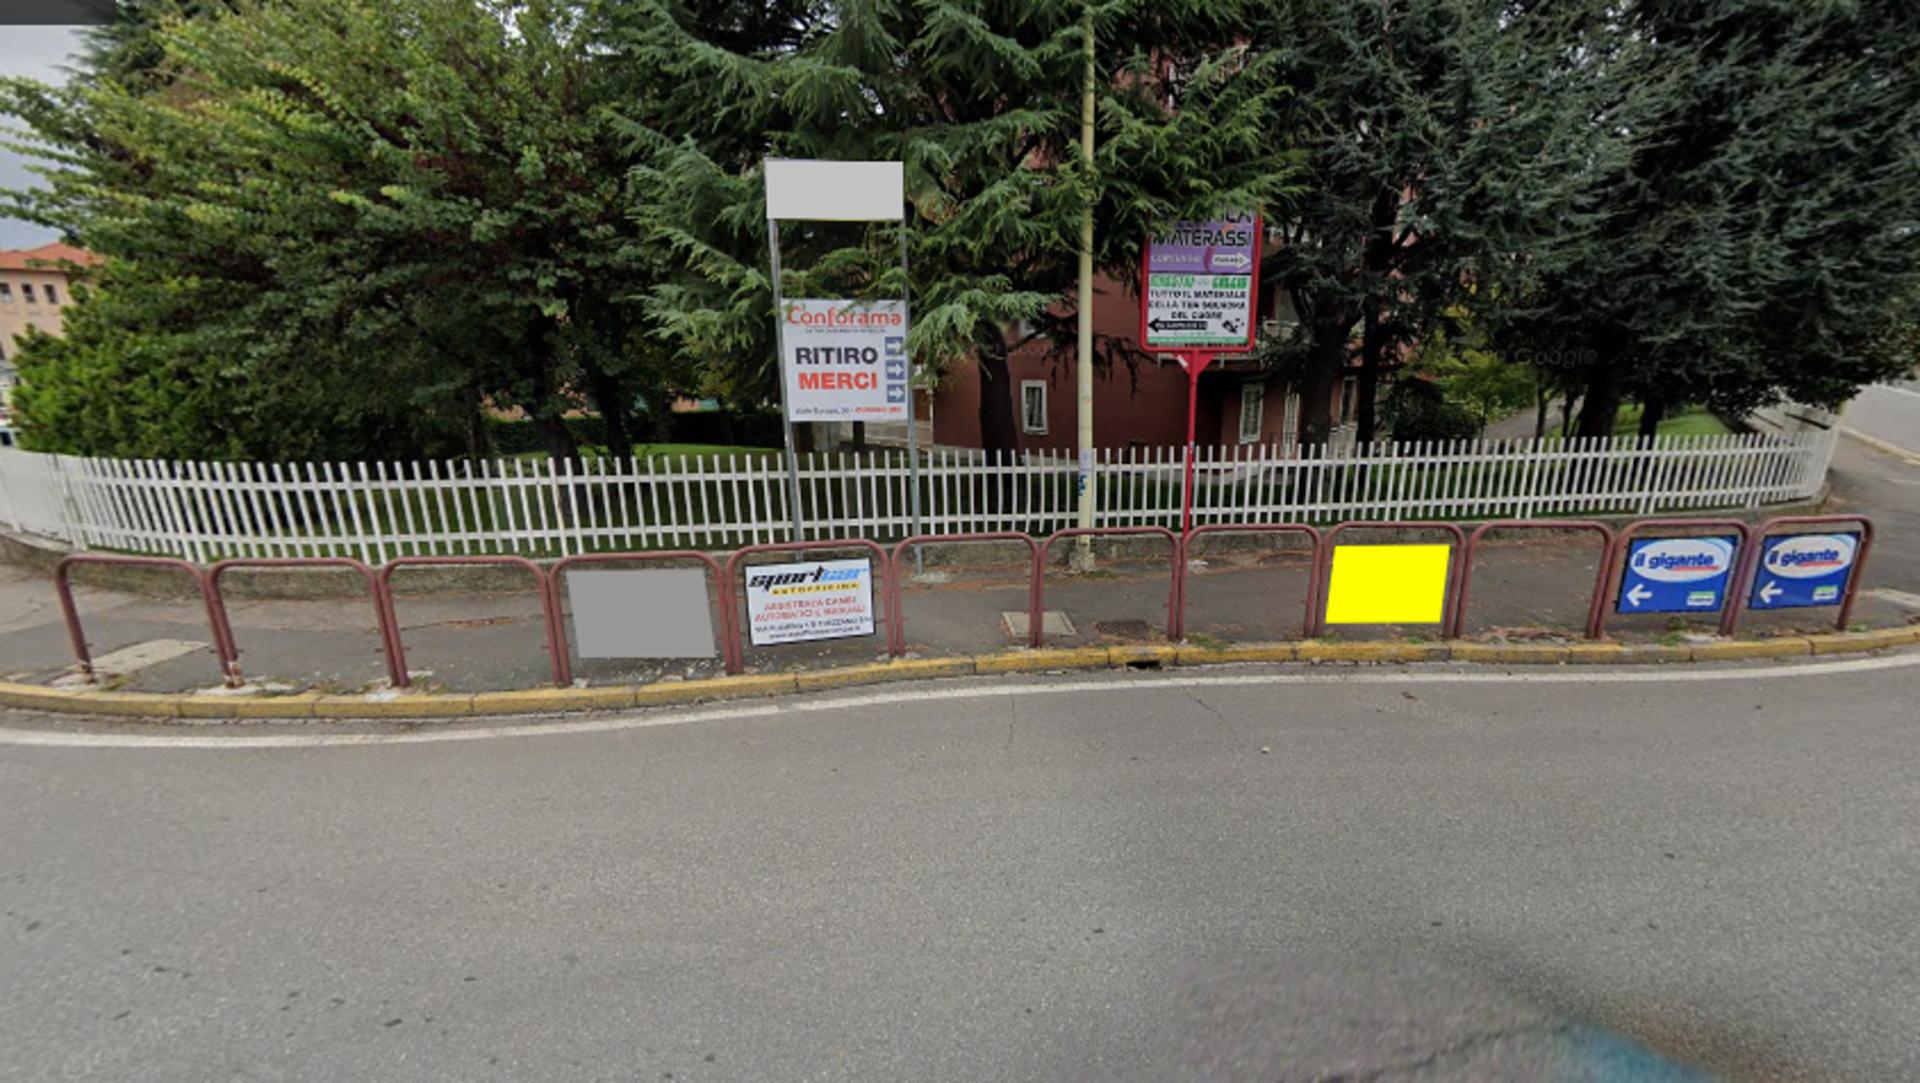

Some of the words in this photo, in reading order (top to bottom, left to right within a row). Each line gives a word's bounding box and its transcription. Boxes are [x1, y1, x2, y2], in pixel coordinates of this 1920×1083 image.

[1194, 290, 1247, 299] MATERIALE
[787, 305, 902, 328] Conforama
[795, 346, 879, 365] RITIRO
[798, 371, 878, 391] MERCI
[1634, 552, 1646, 567] il
[1648, 552, 1715, 570] gigante
[1768, 550, 1779, 565] il
[1780, 548, 1840, 568] gigante
